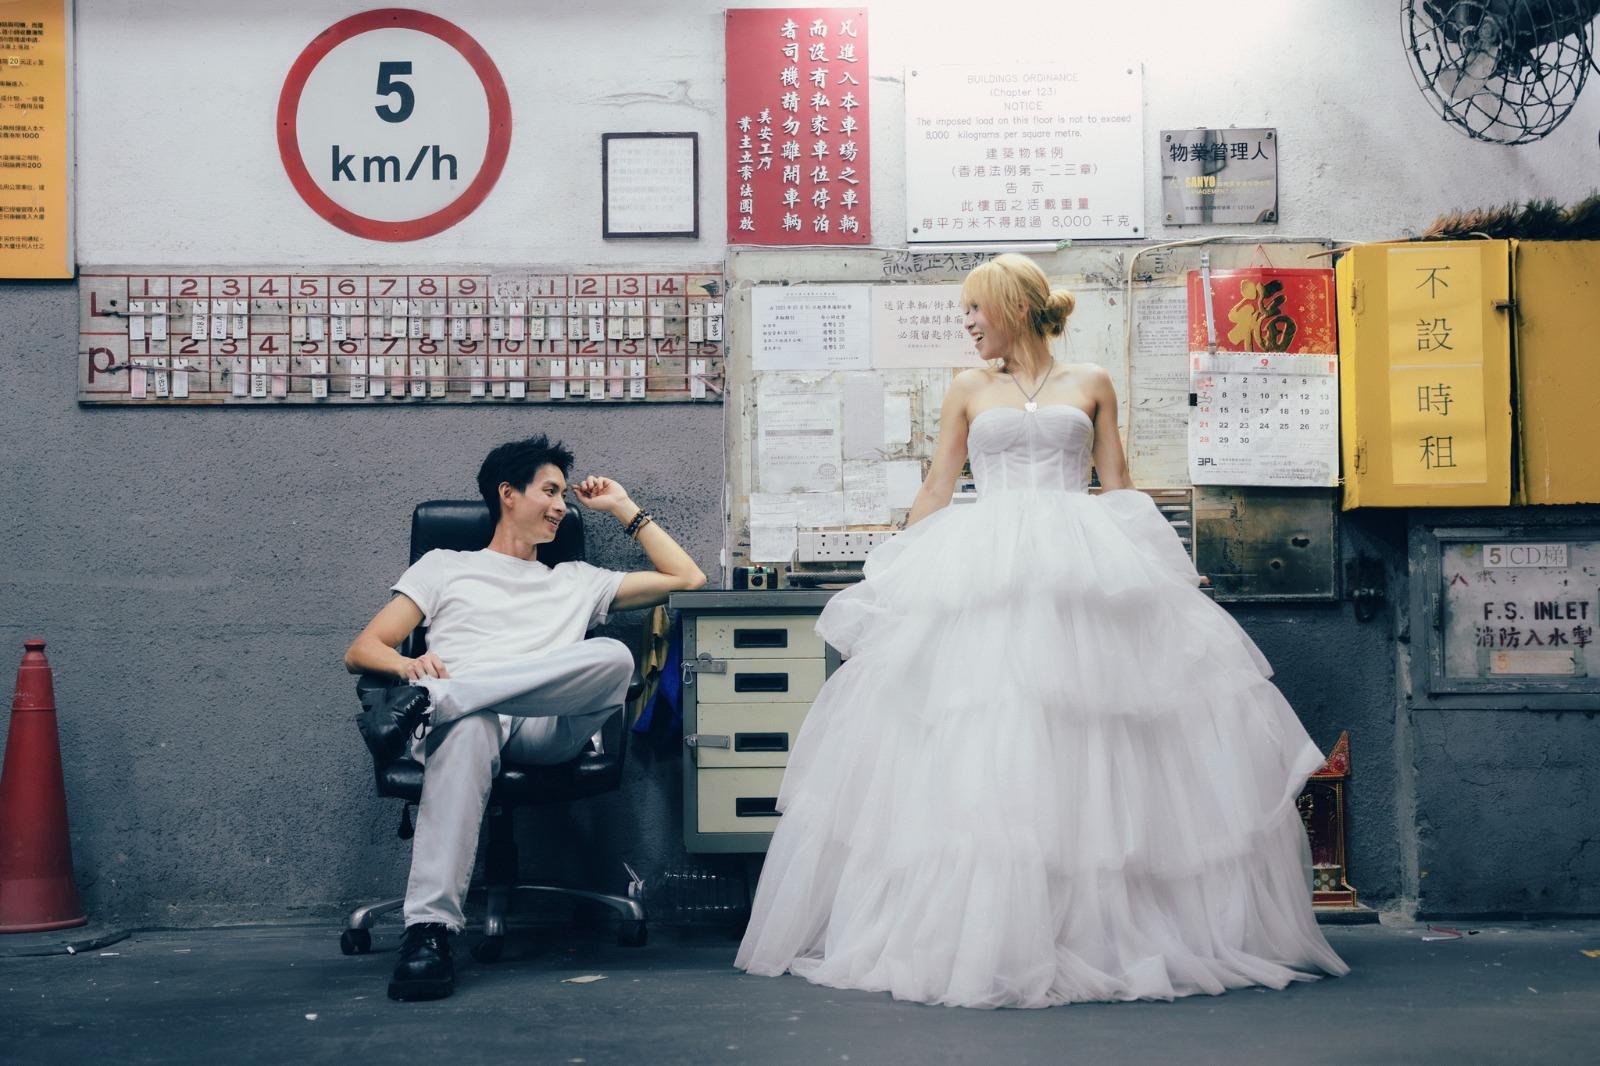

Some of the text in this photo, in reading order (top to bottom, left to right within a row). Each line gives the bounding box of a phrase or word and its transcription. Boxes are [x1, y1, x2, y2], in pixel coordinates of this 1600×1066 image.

[9, 58, 19, 66] 20
[967, 73, 1080, 84] BUILDINGS ORDINANCE
[375, 61, 415, 123] 5
[990, 86, 1058, 98] (Chapter 123)
[1003, 102, 1043, 112] NOTICE
[780, 18, 802, 232] 者司機請勿離開車輛
[809, 18, 832, 233] 而設有私家車位停泊
[838, 19, 860, 234] 凡進入本車場之車輛
[917, 118, 932, 127] The
[936, 117, 971, 128] imposed
[976, 116, 994, 126] load
[1013, 116, 1029, 125] this
[1033, 115, 1053, 125] floor
[1057, 115, 1066, 124] is
[1069, 115, 1084, 124] not
[1088, 115, 1097, 124] to
[1101, 114, 1132, 124] exceed
[22, 132, 39, 140] 1000
[925, 128, 1082, 142] 8,000 kilograms per square metre.
[986, 147, 1064, 160] 建築物條例
[1169, 141, 1269, 162] 物業管理人
[27, 161, 42, 169] 200
[331, 145, 458, 183] km/h
[951, 163, 1099, 178] (香港法例第一二三章)
[1005, 181, 1046, 195] 告示
[961, 198, 1090, 212] 此樓面之活載重量
[922, 214, 1130, 229] 每平方米不得超過 8,000 千克
[144, 279, 149, 296] 1
[180, 279, 198, 296] 2
[222, 278, 240, 296] 3
[258, 279, 279, 296] 4
[300, 279, 318, 296] 5
[338, 279, 355, 295] 6
[379, 279, 397, 295] 7
[418, 278, 437, 295] 8
[459, 278, 477, 295] 9
[575, 278, 597, 294] 12
[616, 278, 639, 294] 13
[656, 278, 678, 294] 14
[90, 292, 105, 317] L
[1228, 280, 1298, 351] 福
[144, 336, 150, 353] 1
[180, 336, 199, 353] 2
[220, 338, 238, 353] 3
[259, 336, 279, 353] 4
[339, 338, 357, 353] 6
[380, 338, 398, 354] 7
[418, 338, 437, 354] 8
[497, 339, 521, 354] 10
[575, 338, 598, 354] 12
[615, 339, 637, 354] 13
[1261, 358, 1269, 367] 9
[1415, 265, 1457, 470] 不設時租
[1300, 393, 1310, 401] 12
[1260, 407, 1270, 415] 17
[1300, 408, 1310, 416] 19
[1259, 422, 1270, 430] 24
[1300, 423, 1310, 431] 26
[1219, 436, 1229, 444] 29
[1490, 545, 1564, 566] 5 CD梯
[1484, 600, 1590, 621] F.S. INLET
[1475, 625, 1593, 649] 消防入水掣
